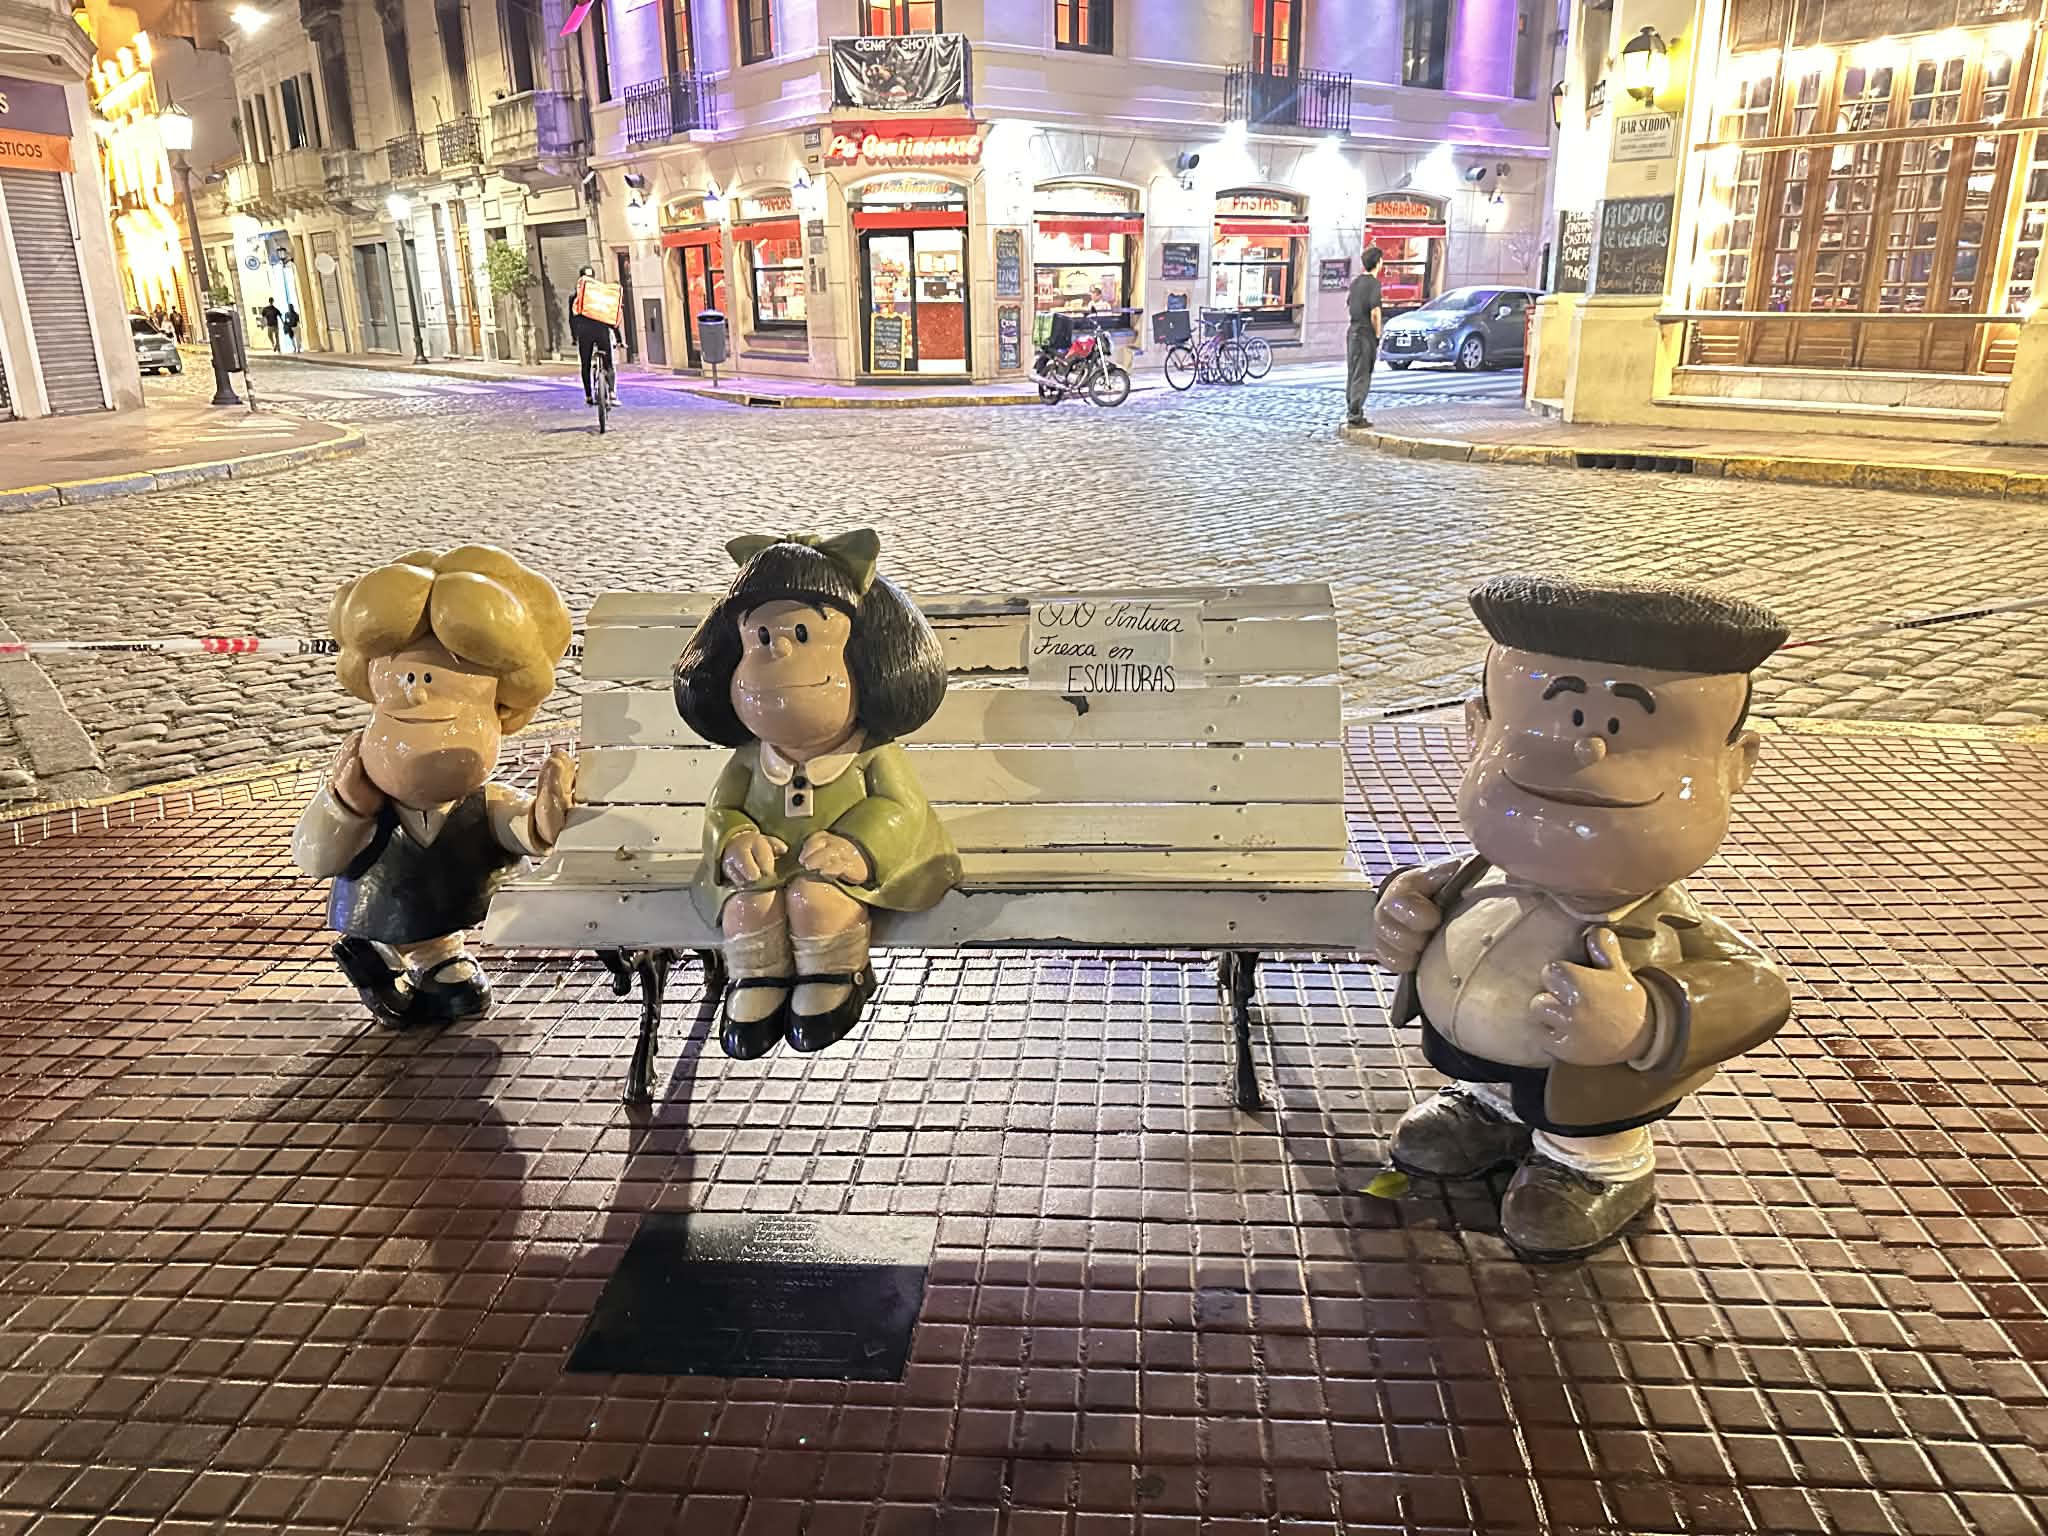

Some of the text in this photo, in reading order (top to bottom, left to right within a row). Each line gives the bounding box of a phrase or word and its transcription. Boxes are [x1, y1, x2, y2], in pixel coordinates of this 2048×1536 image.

[855, 38, 935, 51] CENA SHOW
[1620, 116, 1672, 135] BAR SEDDON
[861, 134, 982, 158] Continental
[1232, 194, 1280, 211] PASTAS
[1604, 202, 1665, 229] RISOTTO
[1105, 602, 1184, 633] Pintura
[1109, 646, 1134, 660] en
[1068, 663, 1176, 694] ESCULTURAS
